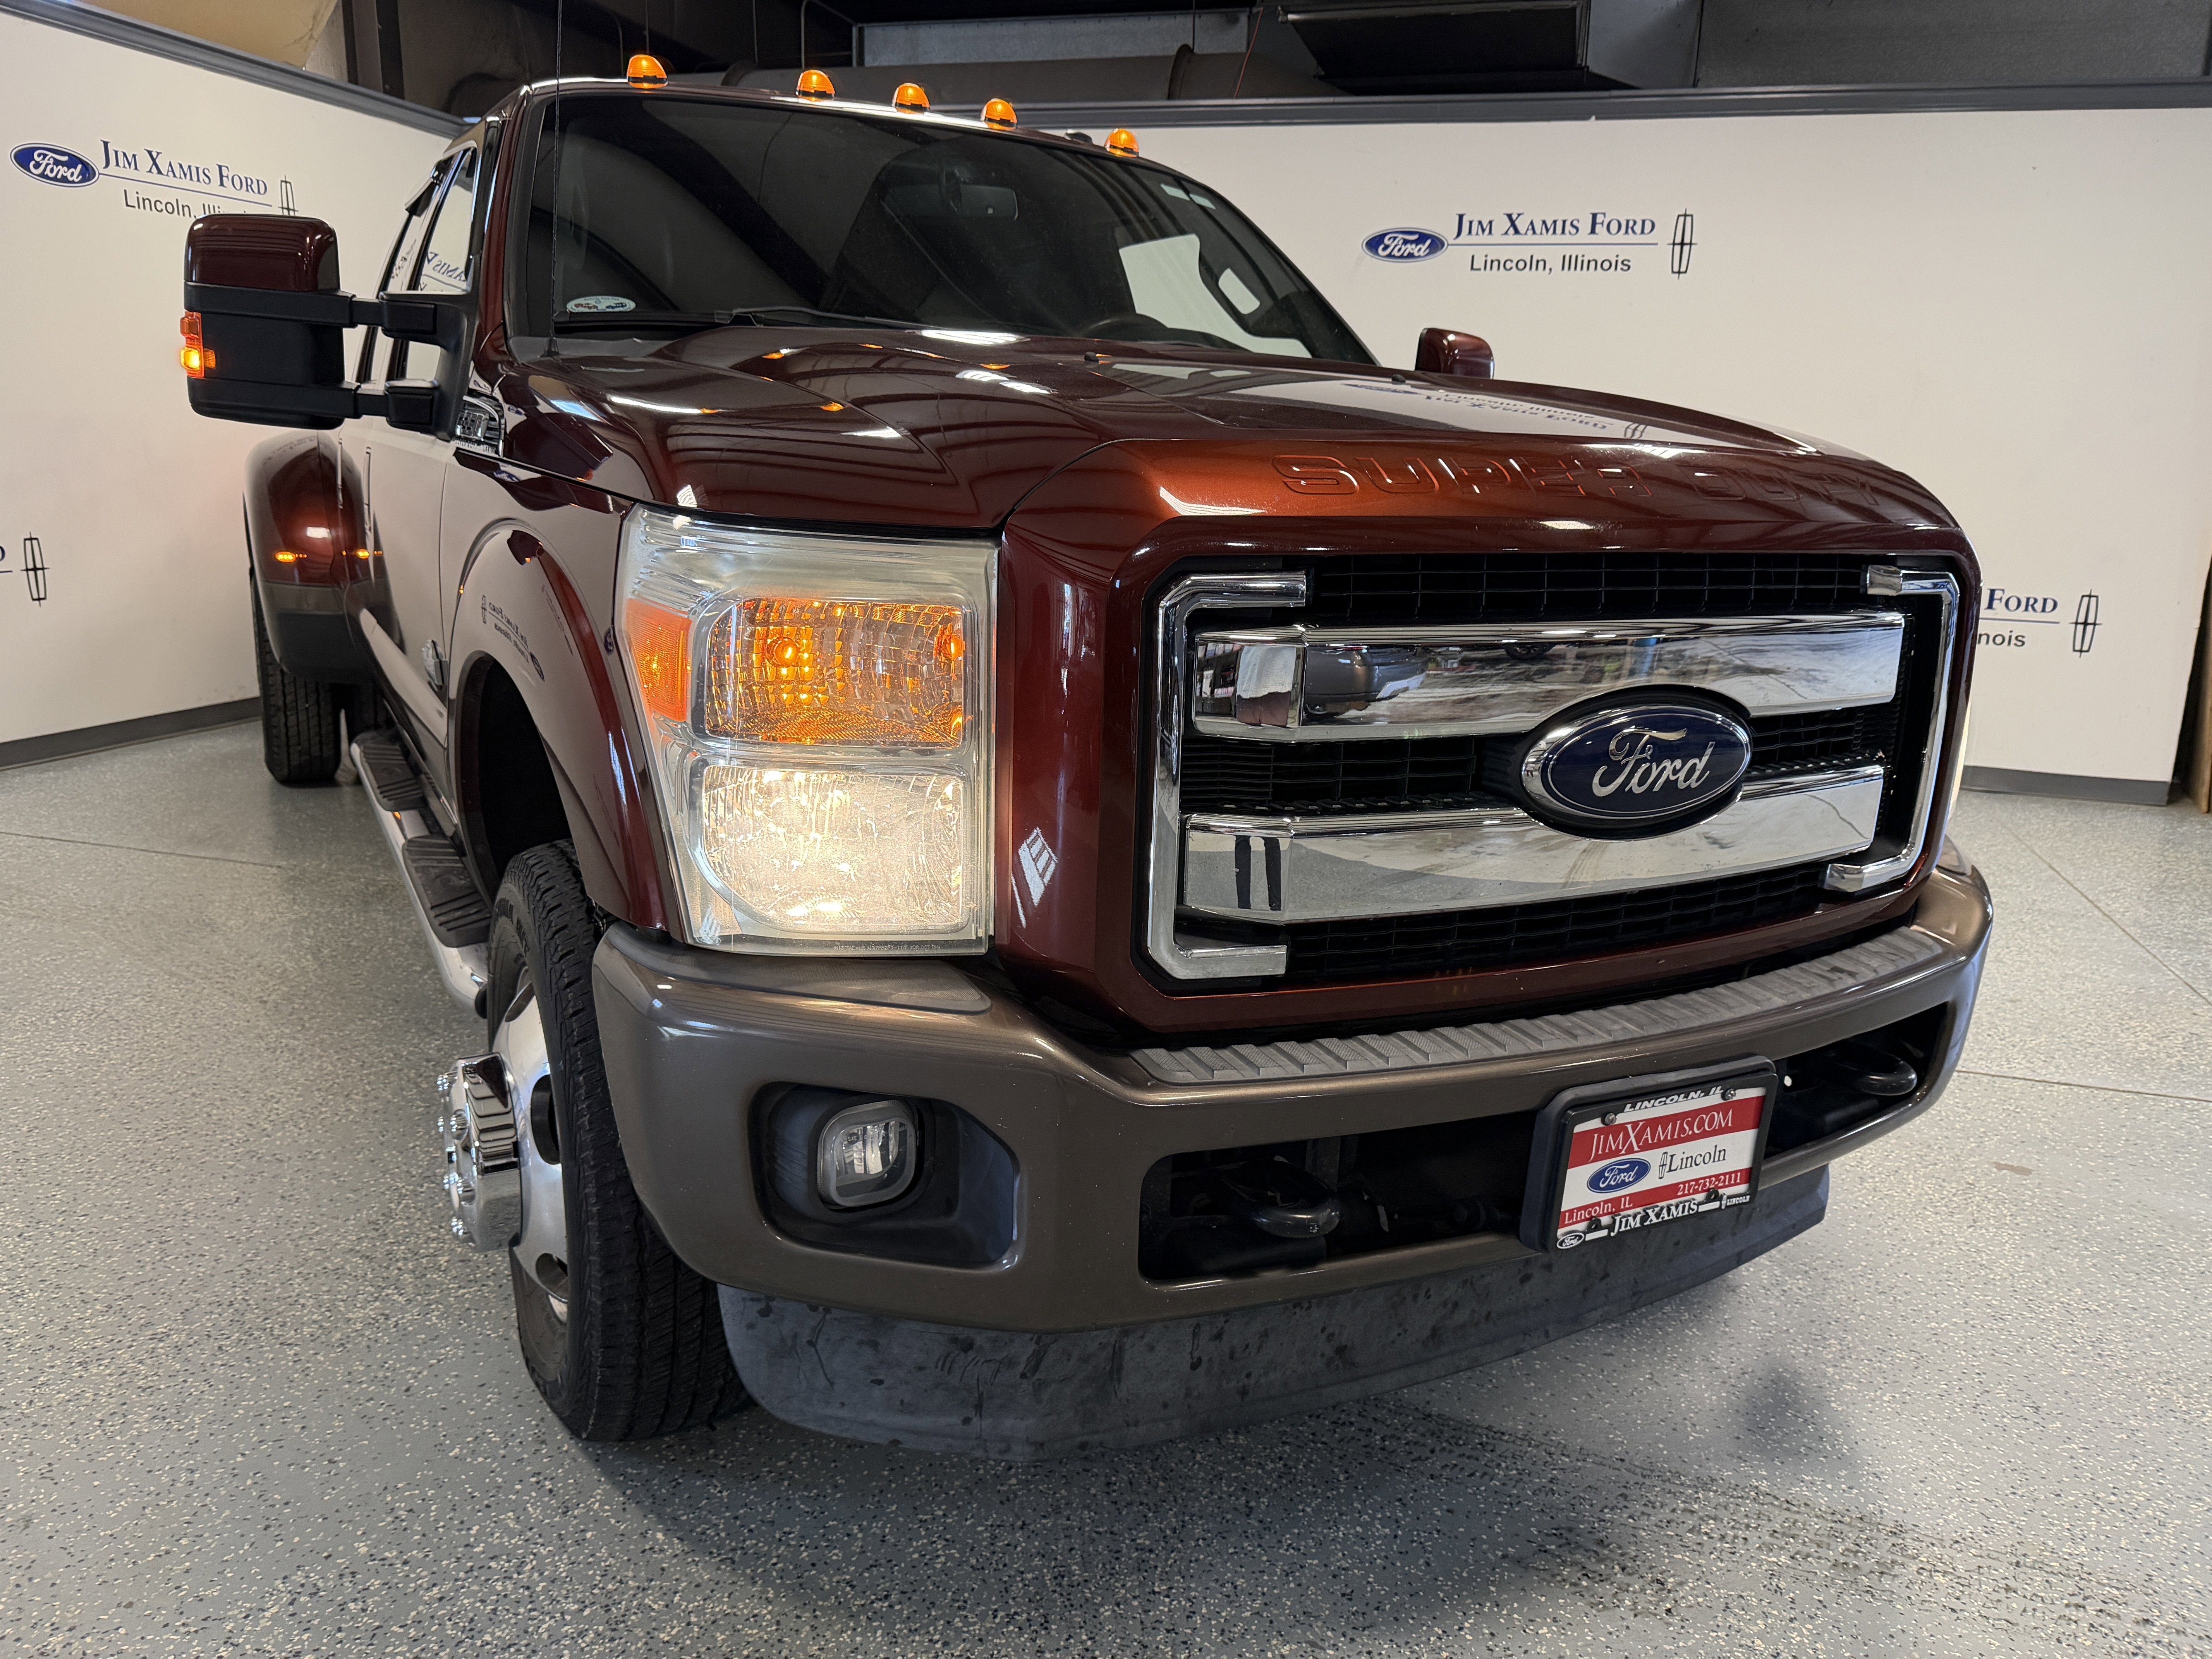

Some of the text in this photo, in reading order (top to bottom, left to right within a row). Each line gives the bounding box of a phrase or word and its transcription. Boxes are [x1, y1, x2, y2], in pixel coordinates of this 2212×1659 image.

[29, 149, 82, 184] Ford
[100, 139, 268, 196] JIM XAMIS FORD
[124, 189, 197, 219] Lincoln,
[1453, 211, 1656, 240] JIM XAMIS FORD
[1377, 234, 1430, 258] Ford
[1470, 254, 1632, 275] Lincoln, Illinois
[1271, 455, 1880, 505] SUPER DUTY
[1984, 588, 2058, 613] FORD
[1977, 629, 2026, 647] nois
[1592, 725, 1716, 797] Ford
[1623, 1085, 1724, 1113] LINCOLN, IL
[1666, 1144, 1727, 1173] Lincoln
[1599, 1164, 1636, 1188] Ford
[1677, 1171, 1741, 1196] 217-732-2111
[1564, 1196, 1633, 1224] Lincoln, IL
[1726, 1195, 1751, 1206] LINCOLN
[1610, 1200, 1698, 1237] JIM XAMIS
[1562, 1235, 1579, 1247] Ford
